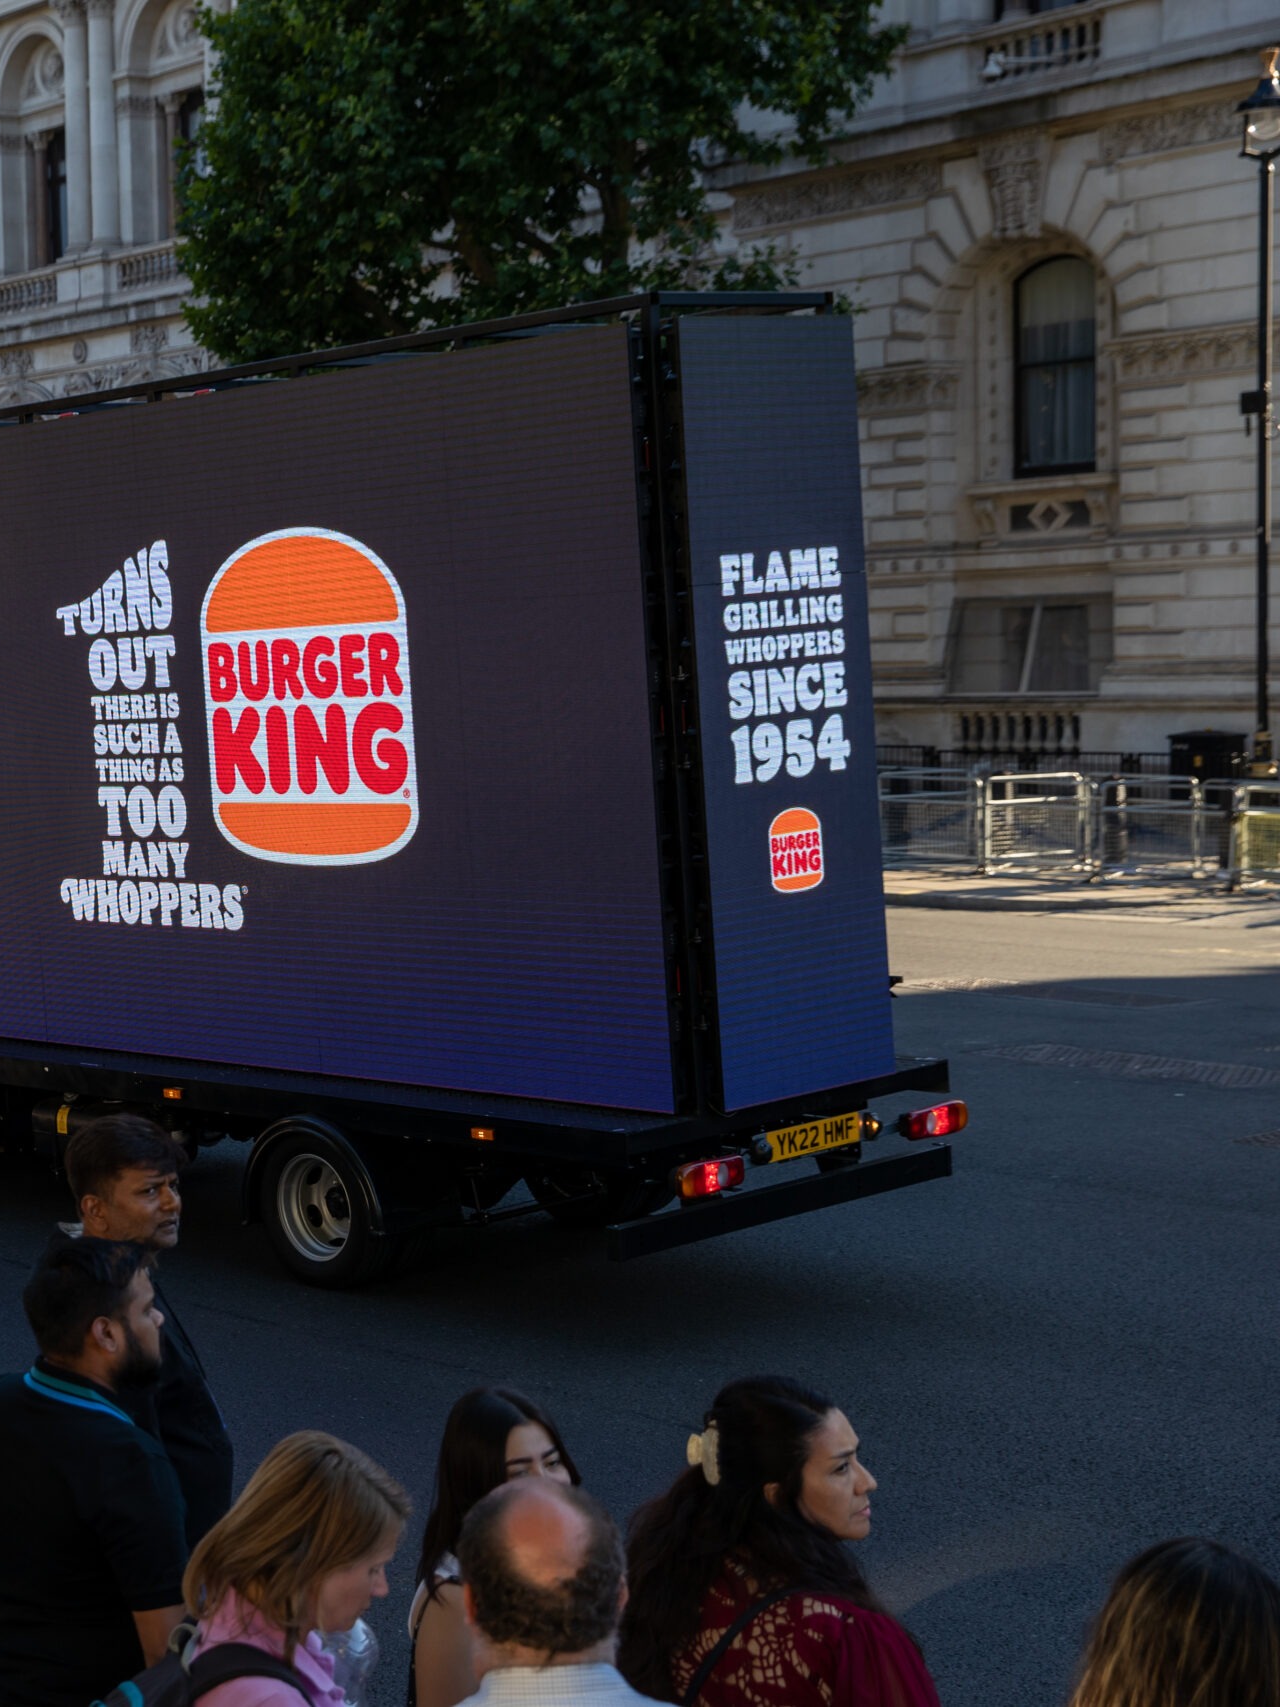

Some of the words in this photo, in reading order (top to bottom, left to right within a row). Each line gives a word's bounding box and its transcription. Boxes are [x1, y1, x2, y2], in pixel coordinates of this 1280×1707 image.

[56, 539, 173, 635] TURNS
[720, 546, 842, 597] FLAME
[723, 594, 844, 632] GRILLING
[88, 635, 176, 691] OUT
[724, 628, 846, 665] WHOPPERS
[207, 631, 405, 703] BURGER
[91, 693, 158, 720] THERE
[159, 692, 180, 720] IS
[728, 661, 849, 720] SINCE
[93, 723, 160, 754] SUCH
[163, 722, 183, 754] A
[211, 701, 409, 796] KING
[730, 713, 852, 785] 1954
[95, 758, 157, 782] THING
[158, 757, 185, 782] AS
[98, 785, 188, 839] TOO
[102, 841, 190, 879] MANY
[771, 830, 820, 853] BURGER
[772, 849, 821, 878] KING
[776, 1125, 820, 1156] YK22
[823, 1116, 854, 1144] HMF
